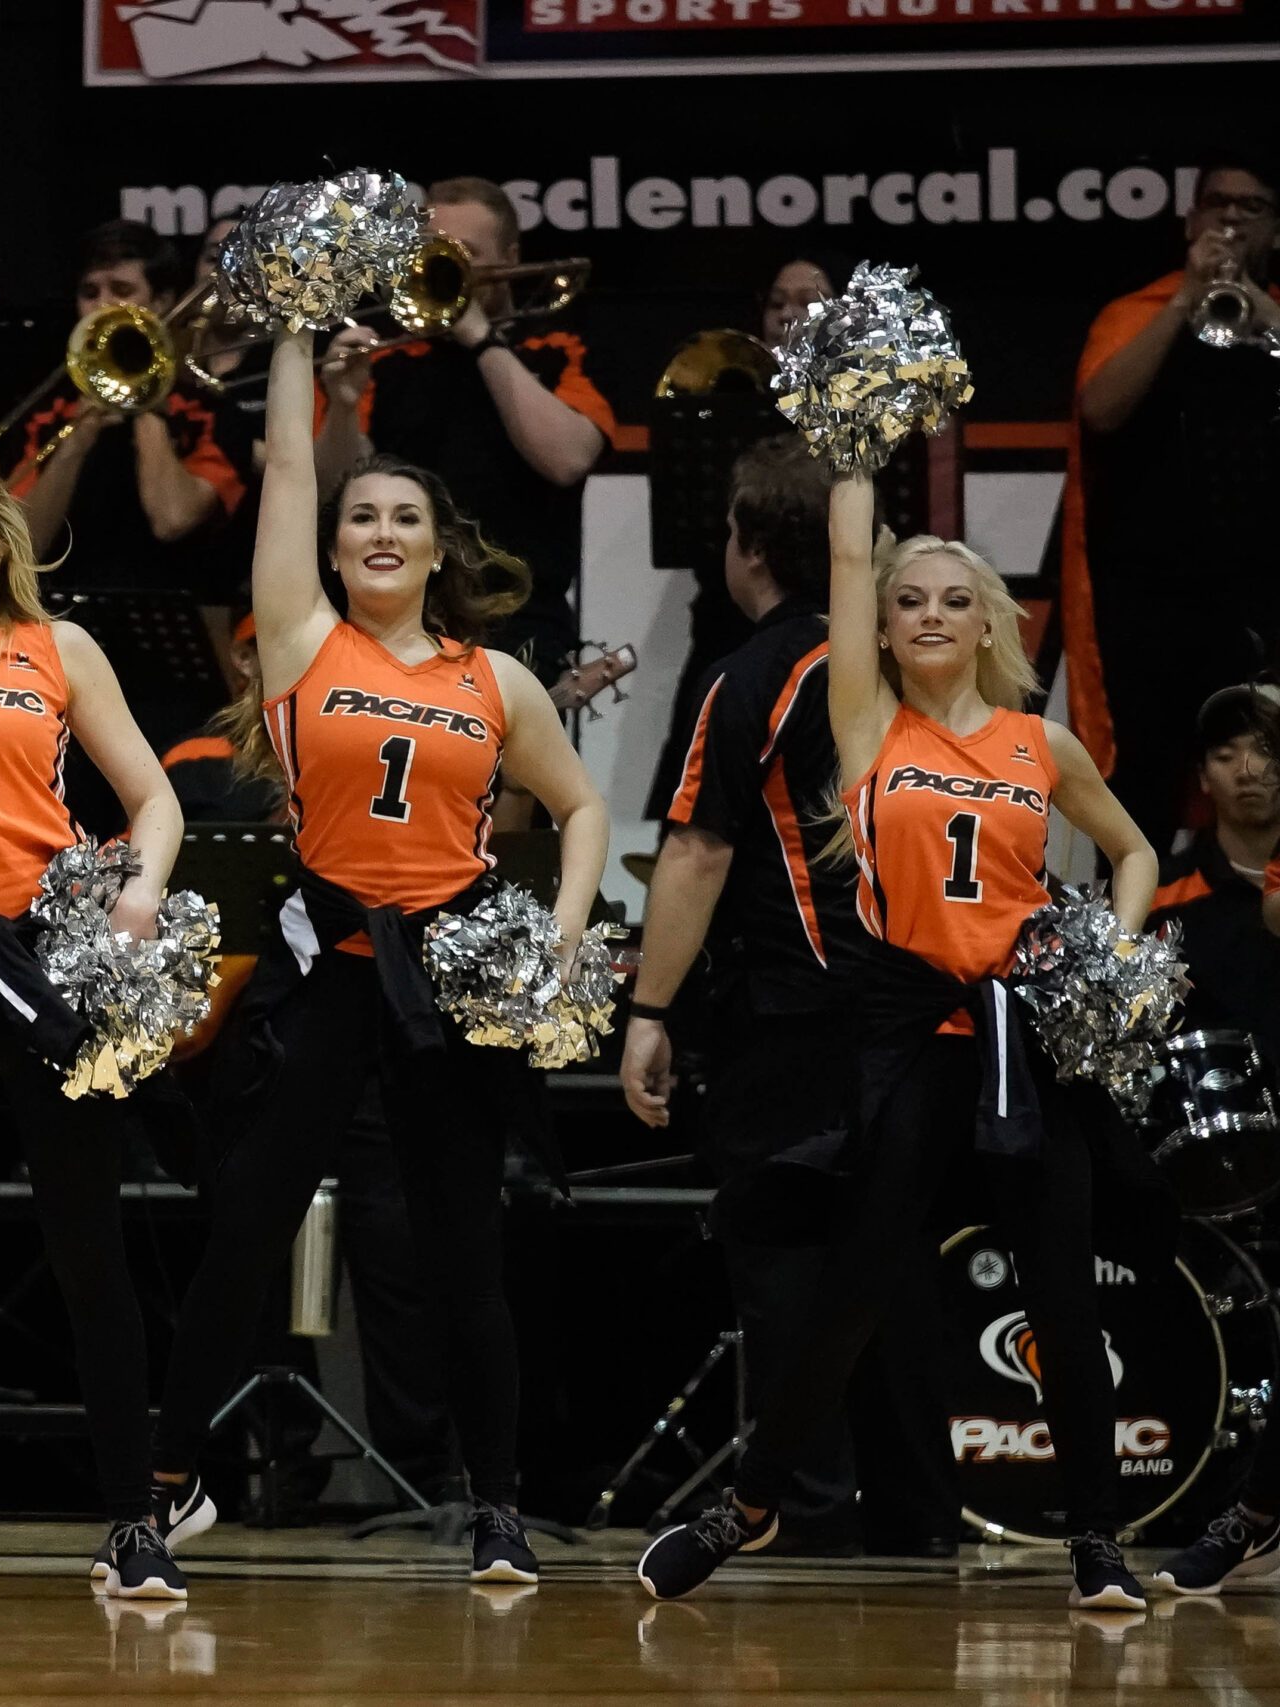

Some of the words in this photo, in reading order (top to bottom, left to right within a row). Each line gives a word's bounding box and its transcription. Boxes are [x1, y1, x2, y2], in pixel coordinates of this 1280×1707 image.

[320, 686, 488, 743] PACIFIC
[369, 734, 417, 825] 1
[883, 764, 1046, 817] PACIFIC
[943, 810, 983, 904] 1
[949, 1416, 1170, 1461] PACIC
[1120, 1458, 1174, 1477] BAND
